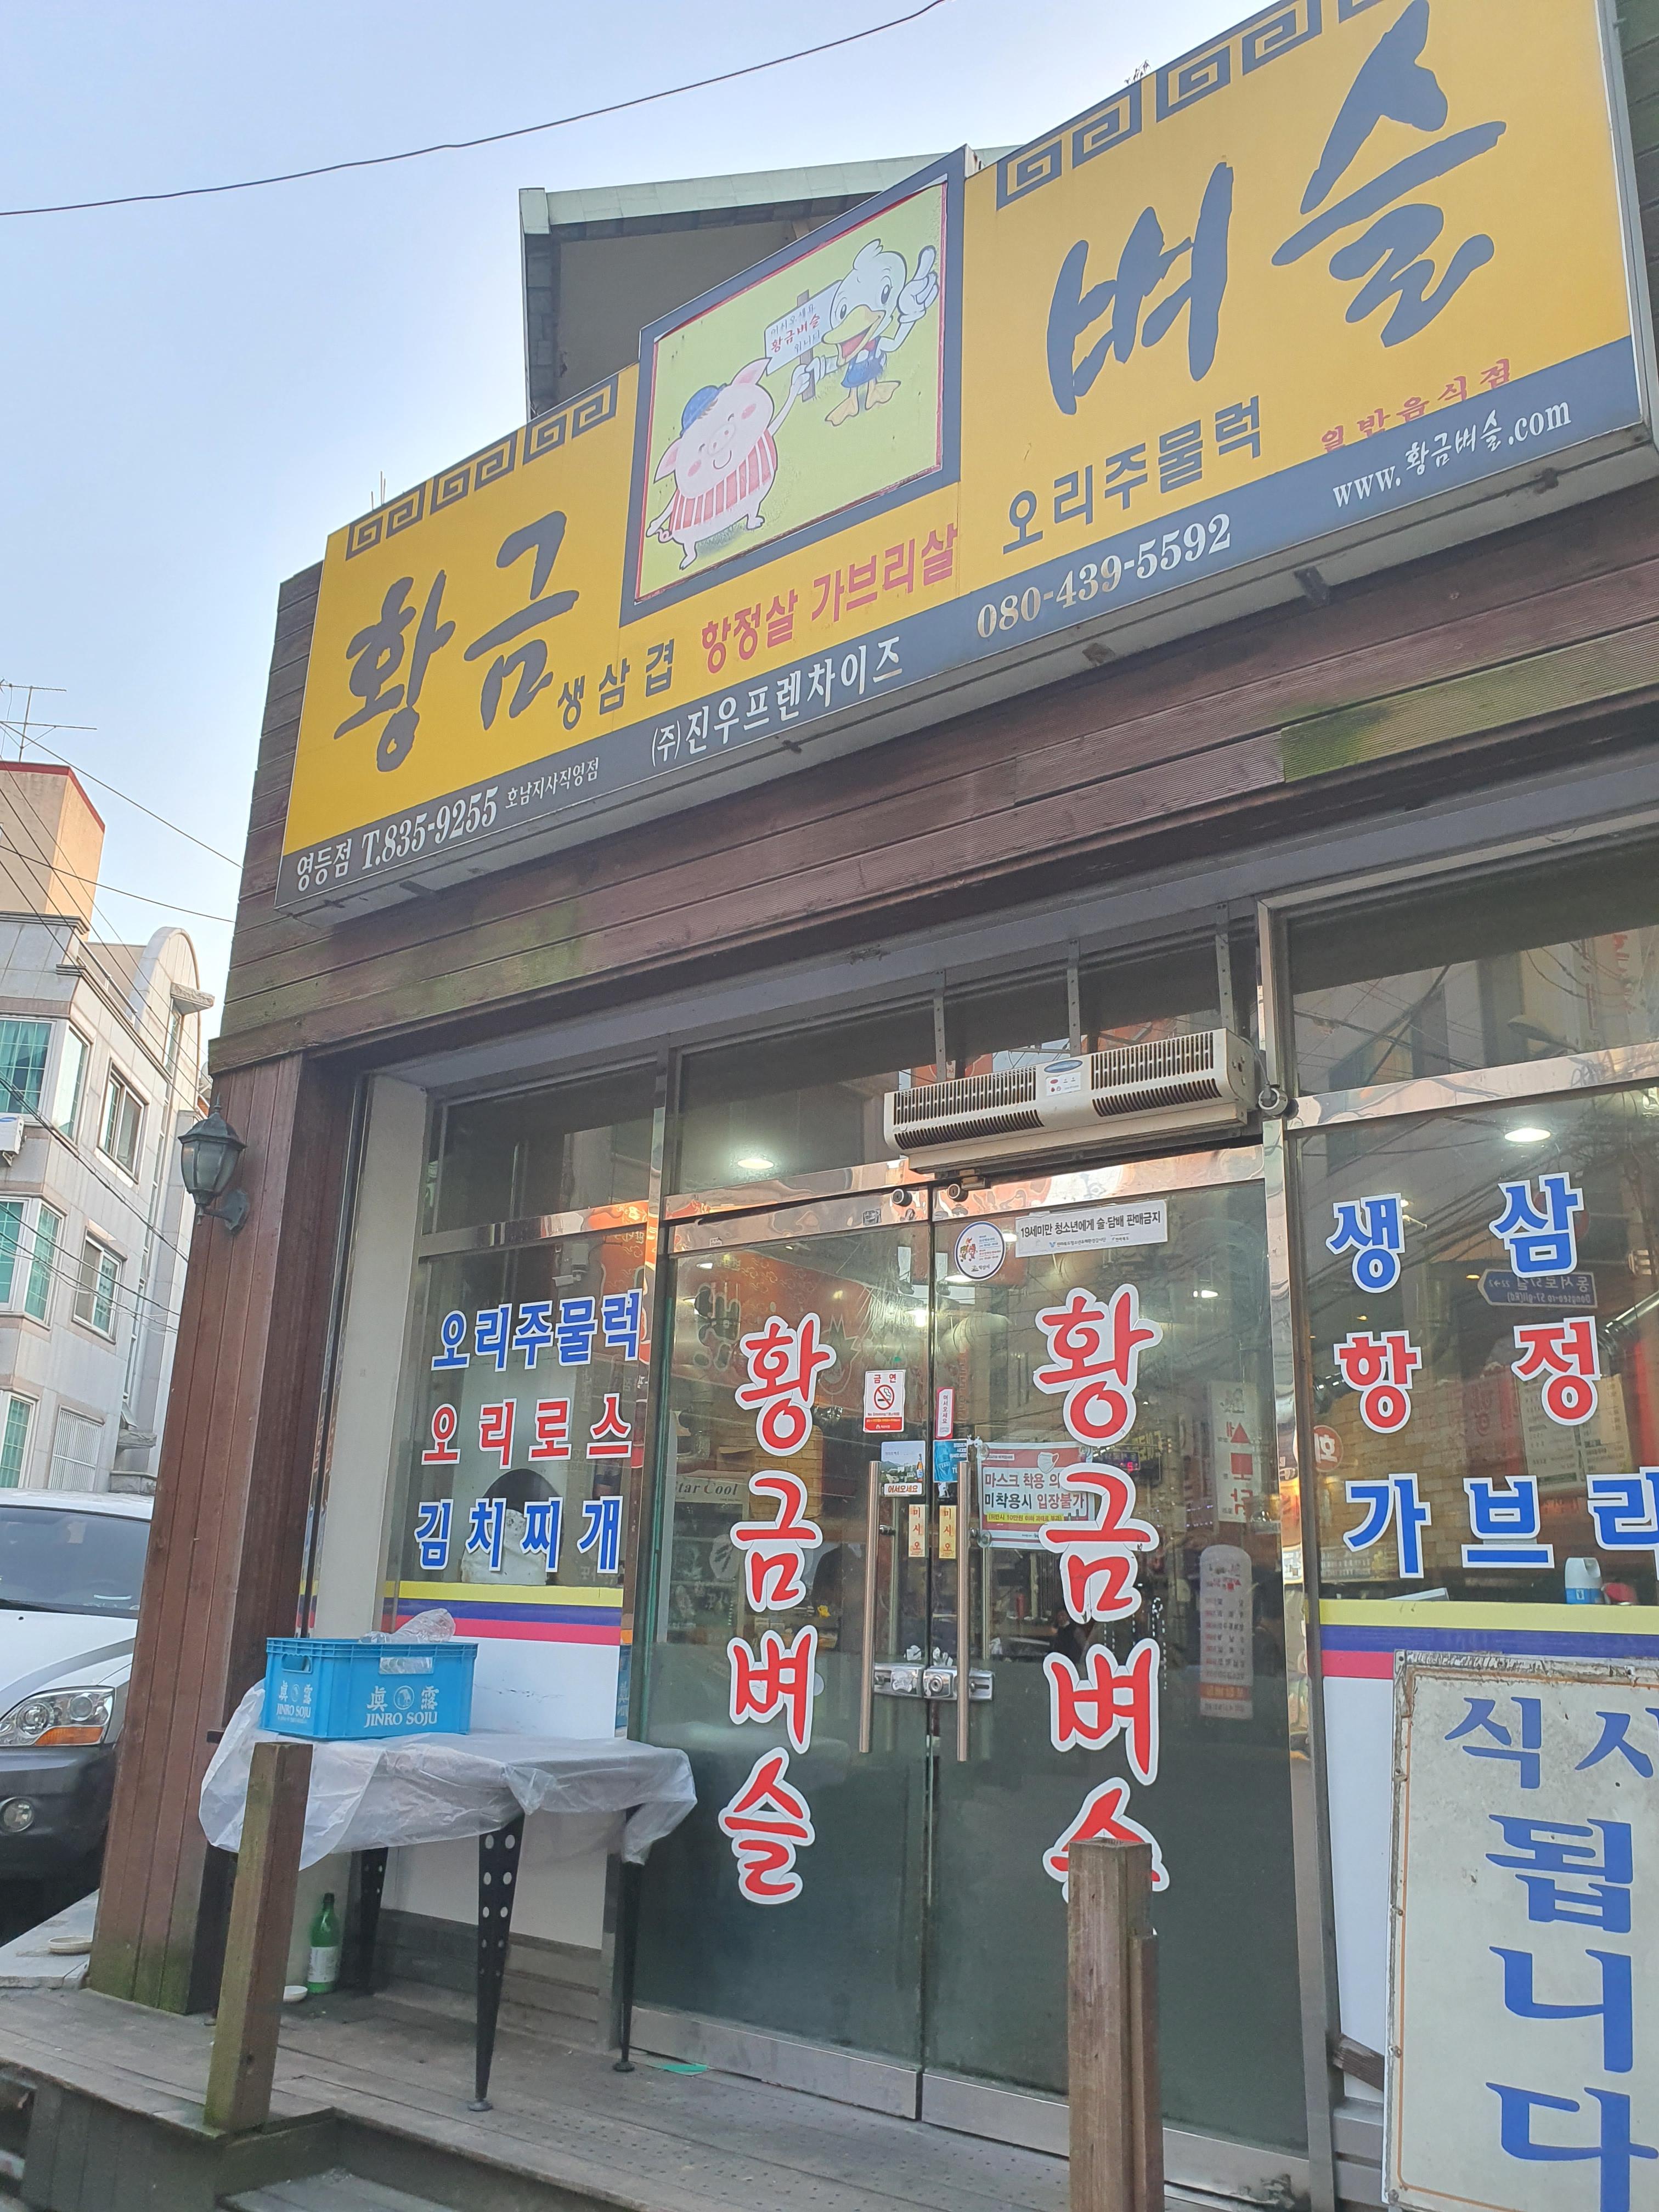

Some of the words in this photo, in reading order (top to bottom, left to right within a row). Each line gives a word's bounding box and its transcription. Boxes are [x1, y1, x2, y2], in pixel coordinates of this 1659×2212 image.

[702, 588, 798, 674] 항정살
[811, 522, 958, 623] 가브리살
[1003, 395, 1261, 555] 오리주물럭
[334, 510, 579, 772] 황금
[296, 838, 352, 893] 영등점
[361, 786, 499, 871] T.835-9255
[504, 757, 600, 809] 호남지사직영점
[651, 636, 903, 767] (주)진우프렌차이즈
[977, 512, 1231, 639] 080-439-5592
[1020, 1224, 1053, 1238] 19세미만
[1054, 1219, 1094, 1235] 청소년에게
[1126, 1210, 1160, 1227] 판매금지
[432, 1289, 642, 1371] 오리주물럭
[422, 1393, 631, 1469] 오리로스
[675, 1481, 701, 1494] tar
[703, 1482, 738, 1496] Cool
[888, 1485, 918, 1493] 어서오세요
[985, 1472, 1019, 1488] 마스크
[1023, 1472, 1045, 1489] 착용
[1049, 1472, 1060, 1488] 의
[985, 1492, 1032, 1509] 미착용시
[1037, 1493, 1085, 1509] 입장불가
[415, 1497, 623, 1573] 김치찌개
[912, 1506, 922, 1550] 미시오
[943, 1508, 953, 1552] 미시오
[720, 1314, 835, 1902] 황금벼슬
[276, 1703, 295, 1717] JINRO
[295, 1705, 312, 1719] SOJU
[364, 1712, 403, 1729] JINRO
[406, 1711, 438, 1726] SOJU
